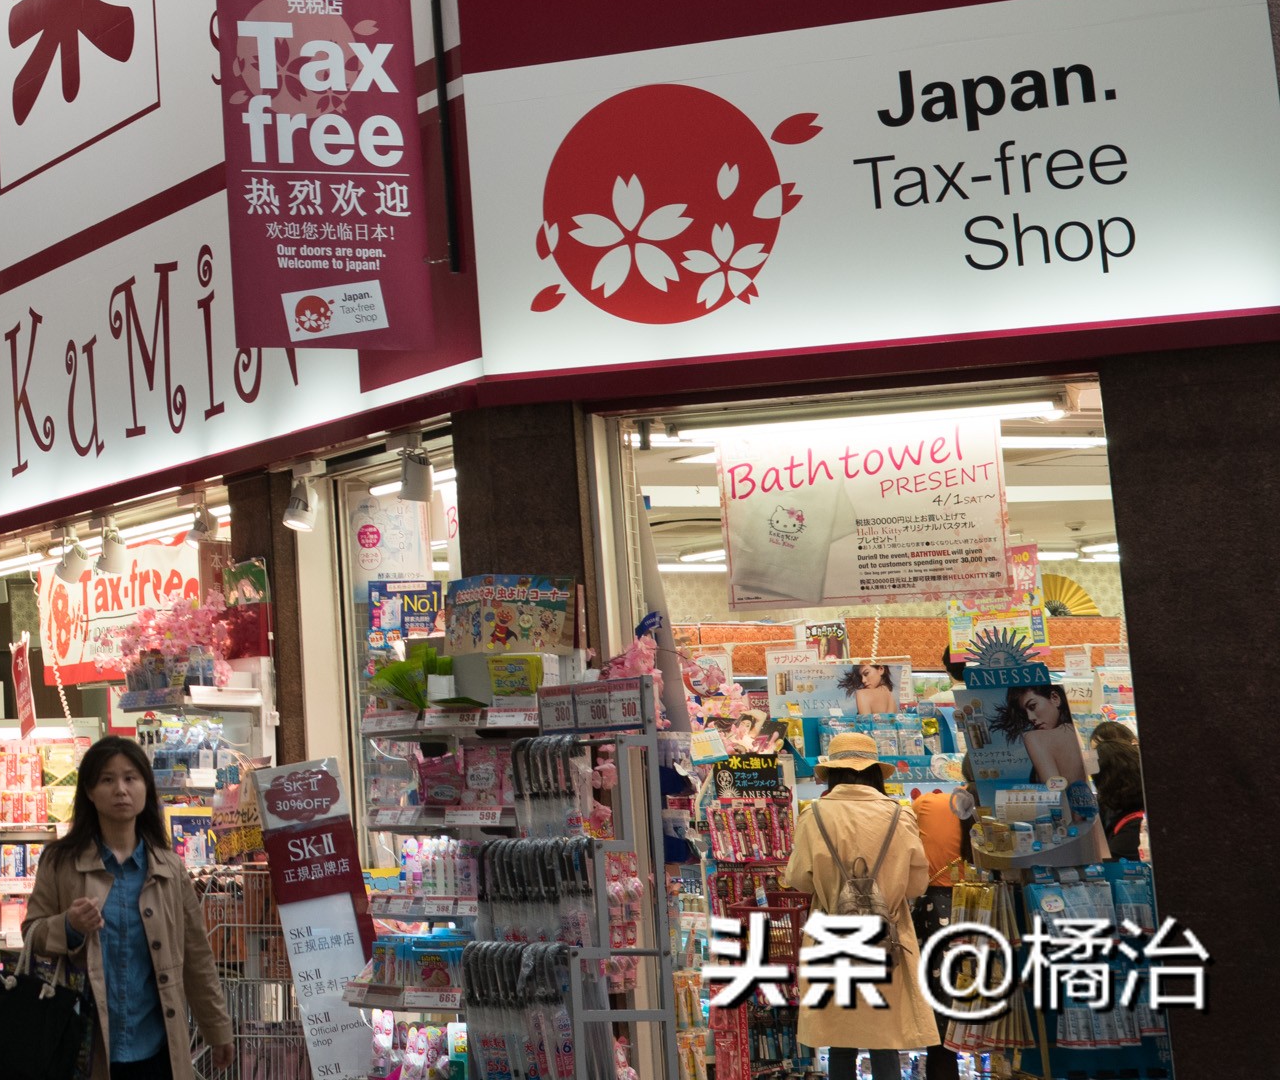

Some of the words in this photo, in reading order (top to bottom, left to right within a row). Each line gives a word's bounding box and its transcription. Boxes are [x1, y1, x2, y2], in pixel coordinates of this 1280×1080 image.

[237, 20, 399, 94] Tax
[877, 61, 1118, 131] Japan.
[242, 94, 405, 169] free
[853, 141, 1129, 210] Tax-free
[244, 178, 412, 218] 热烈欢迎
[266, 222, 395, 241] 欢迎您光临日本!
[277, 244, 296, 256] Our
[300, 245, 332, 256] doors
[335, 247, 353, 256] are
[356, 247, 386, 259] open.
[963, 214, 1137, 275] Shop
[277, 257, 329, 268] Welcome
[332, 258, 343, 269] to
[346, 259, 380, 272] japan!
[342, 291, 372, 302] Japan.
[340, 302, 375, 315] Tax-free
[355, 314, 378, 324] Shop
[727, 447, 834, 501] Bath
[839, 423, 963, 479] towel
[880, 461, 994, 499] PRESENT
[856, 527, 879, 536] Hello
[857, 552, 878, 561] During
[911, 550, 950, 558] BATHTOWEL
[965, 548, 982, 556] given
[878, 560, 912, 568] customers
[914, 558, 943, 567] spending
[961, 556, 982, 564] 30,000
[403, 592, 437, 613] No.1
[774, 655, 810, 663] サプリメント
[969, 667, 1048, 687] ANESSA
[591, 704, 607, 720] 500
[276, 798, 331, 811] 30%OFF
[479, 811, 497, 820] 598
[284, 858, 350, 883] 正規品牌店
[438, 992, 457, 1003] 665
[310, 1023, 338, 1036] Official
[312, 1038, 332, 1047] shop
